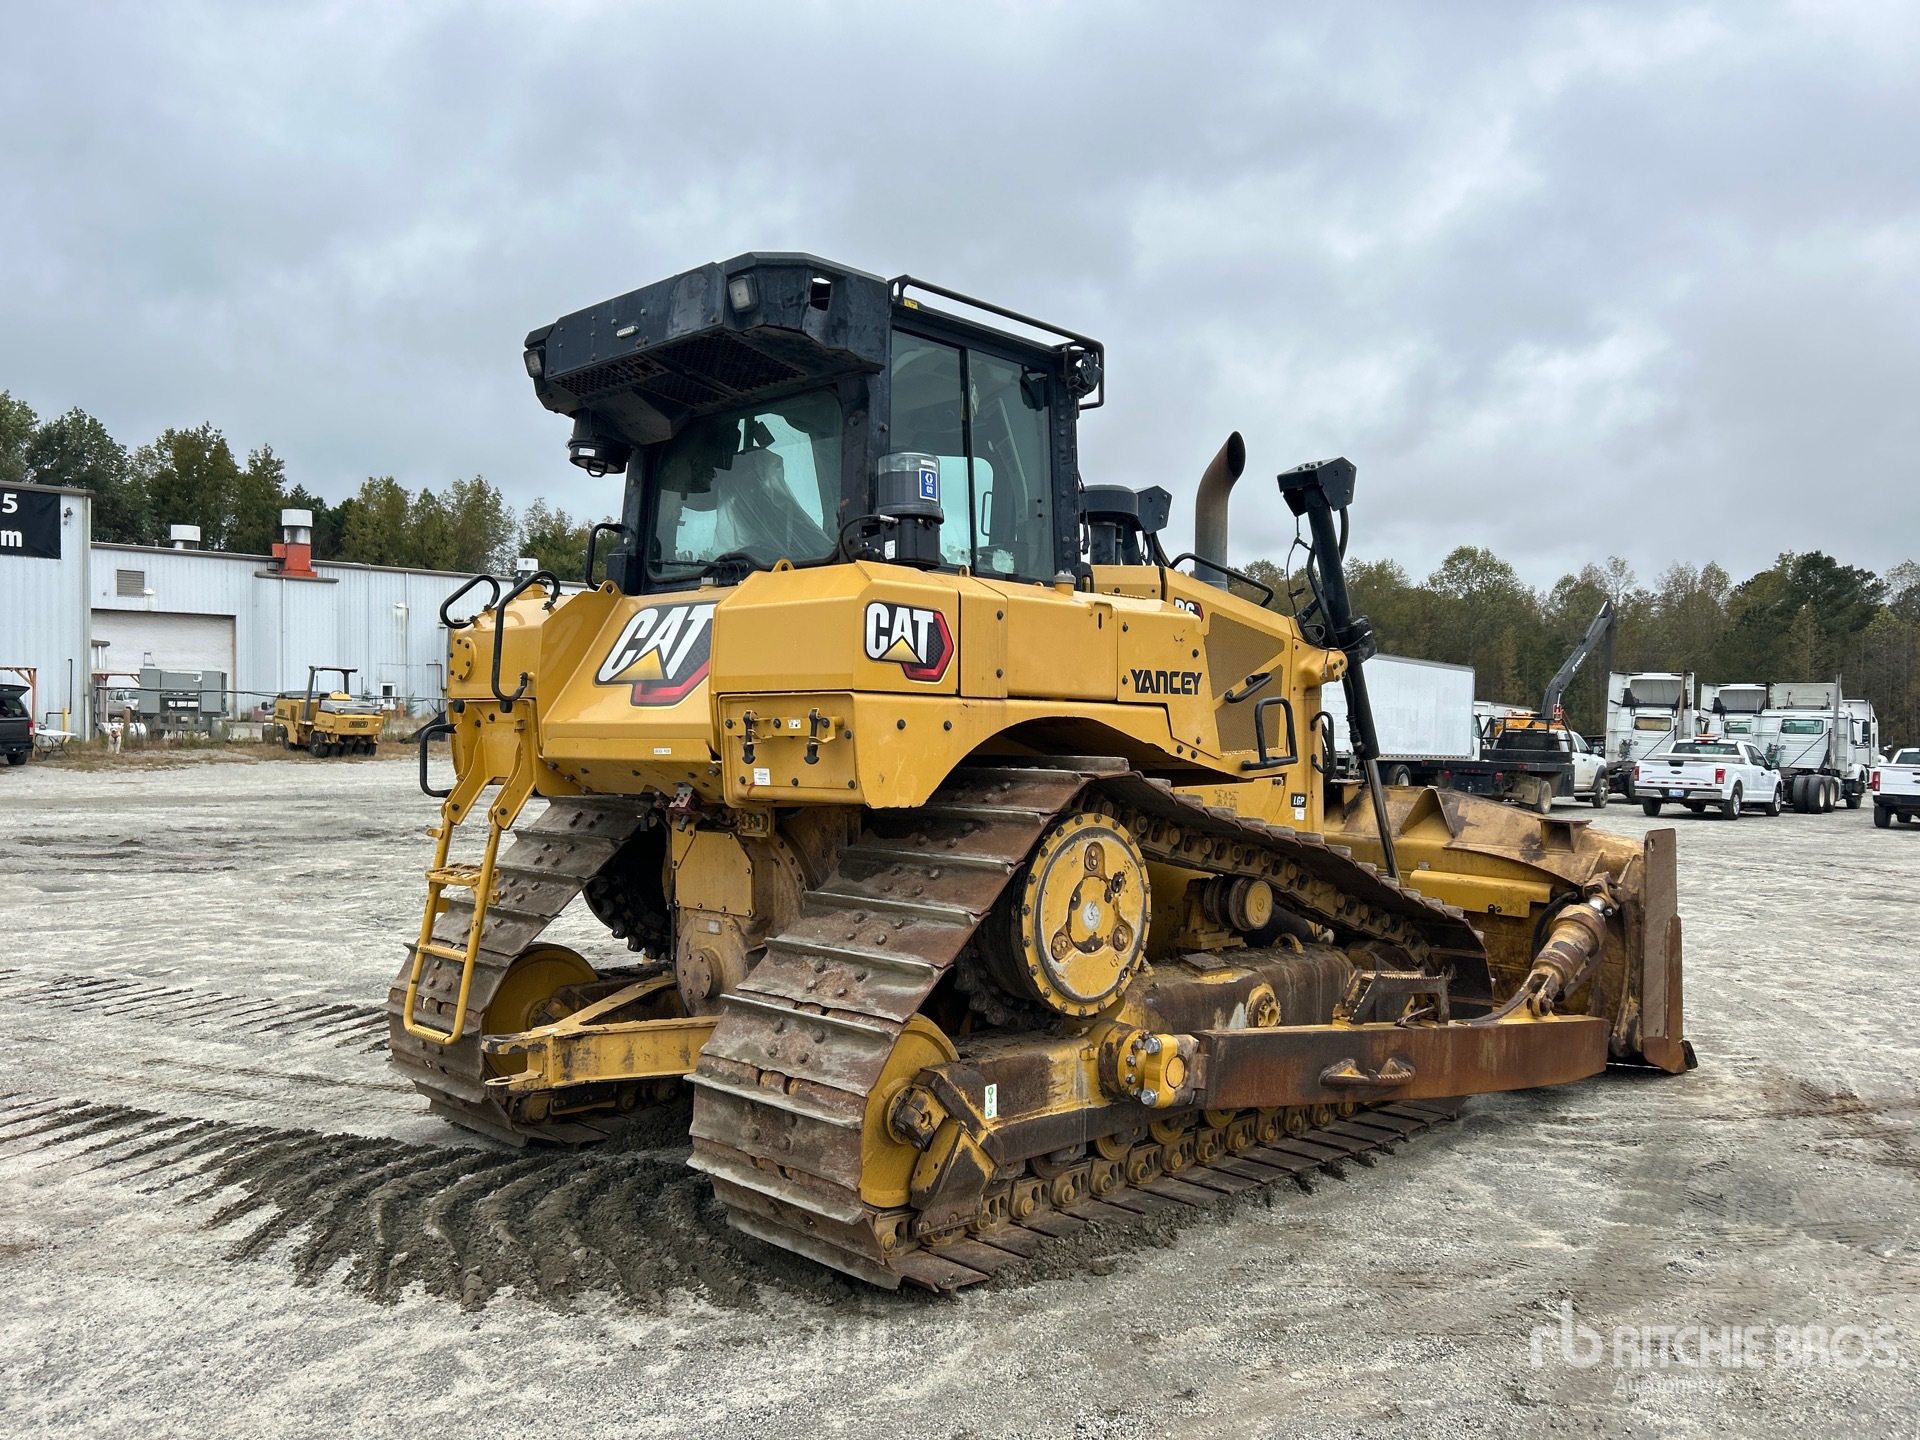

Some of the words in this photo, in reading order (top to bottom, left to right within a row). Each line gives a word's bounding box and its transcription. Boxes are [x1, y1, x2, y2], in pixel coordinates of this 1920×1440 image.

[598, 604, 717, 682] CAT
[866, 602, 934, 664] CAT
[1130, 669, 1202, 695] YANCEY
[1293, 795, 1305, 806] LGP
